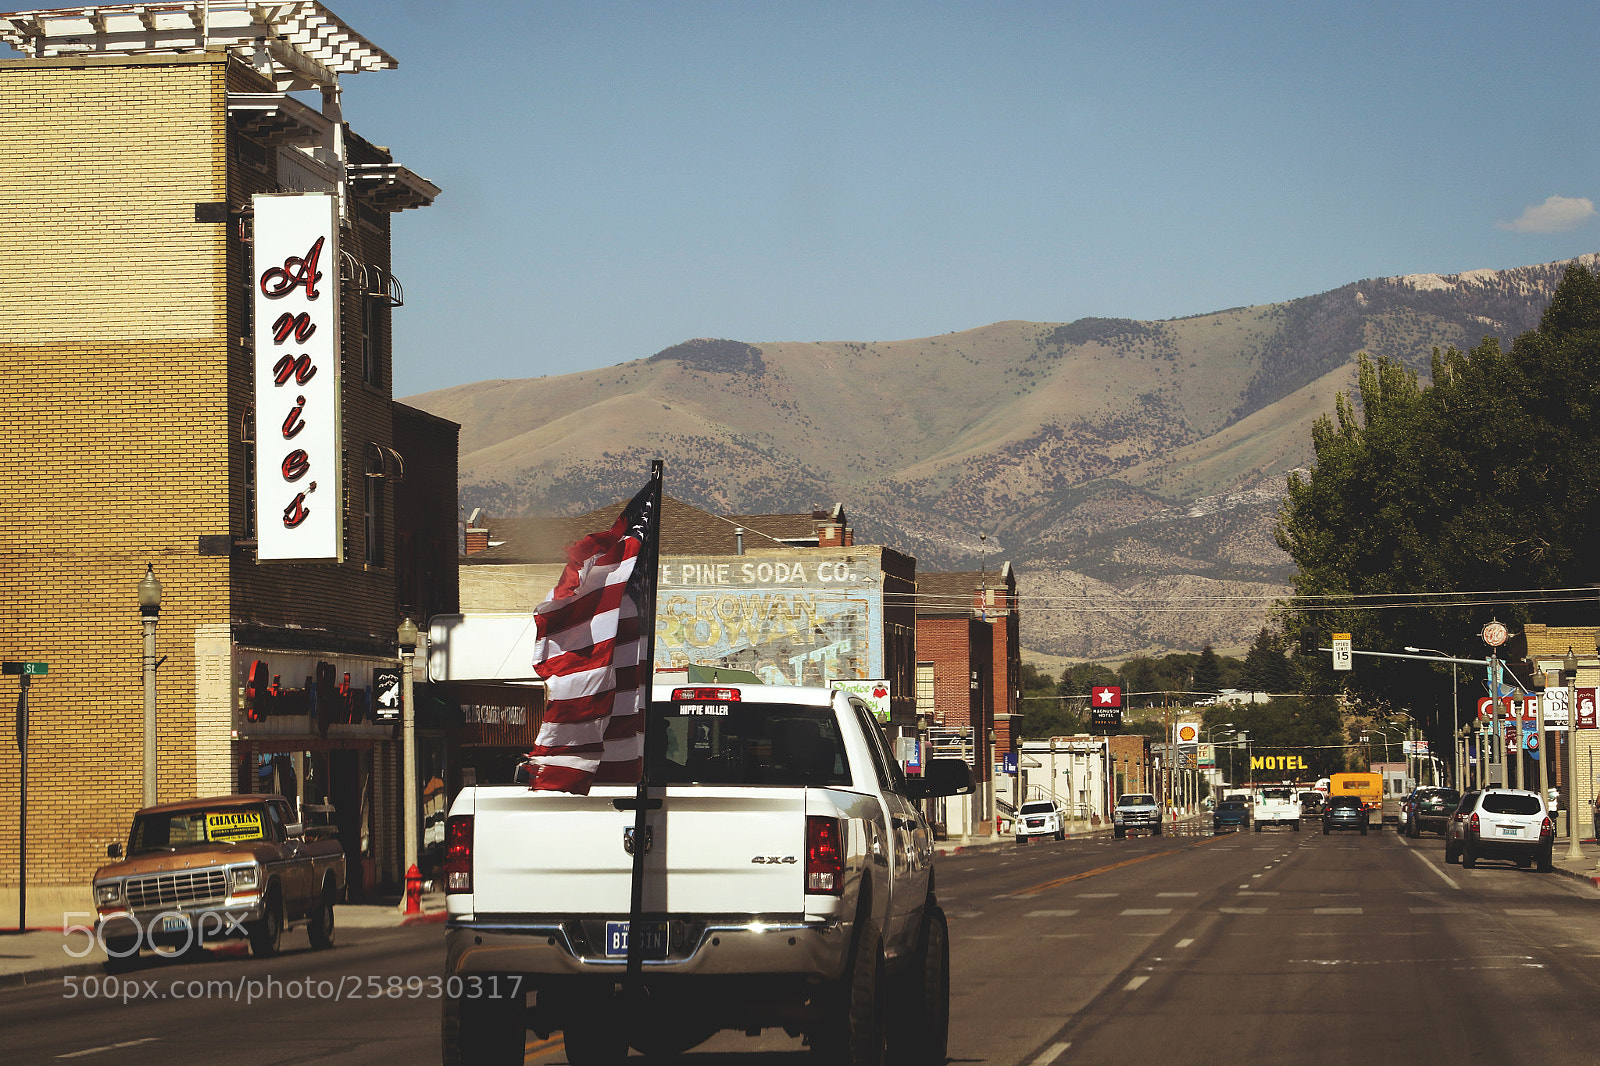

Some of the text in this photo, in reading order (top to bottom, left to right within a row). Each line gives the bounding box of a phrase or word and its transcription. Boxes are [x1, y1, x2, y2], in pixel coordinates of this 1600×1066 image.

[682, 563, 730, 584] PINE
[741, 562, 808, 583] SODA
[696, 593, 817, 620] ROWAN
[1336, 651, 1349, 661] 15
[680, 704, 729, 716] HIPPIE KILLER
[1250, 755, 1308, 770] MOTEL
[209, 813, 258, 826] CHACHAS
